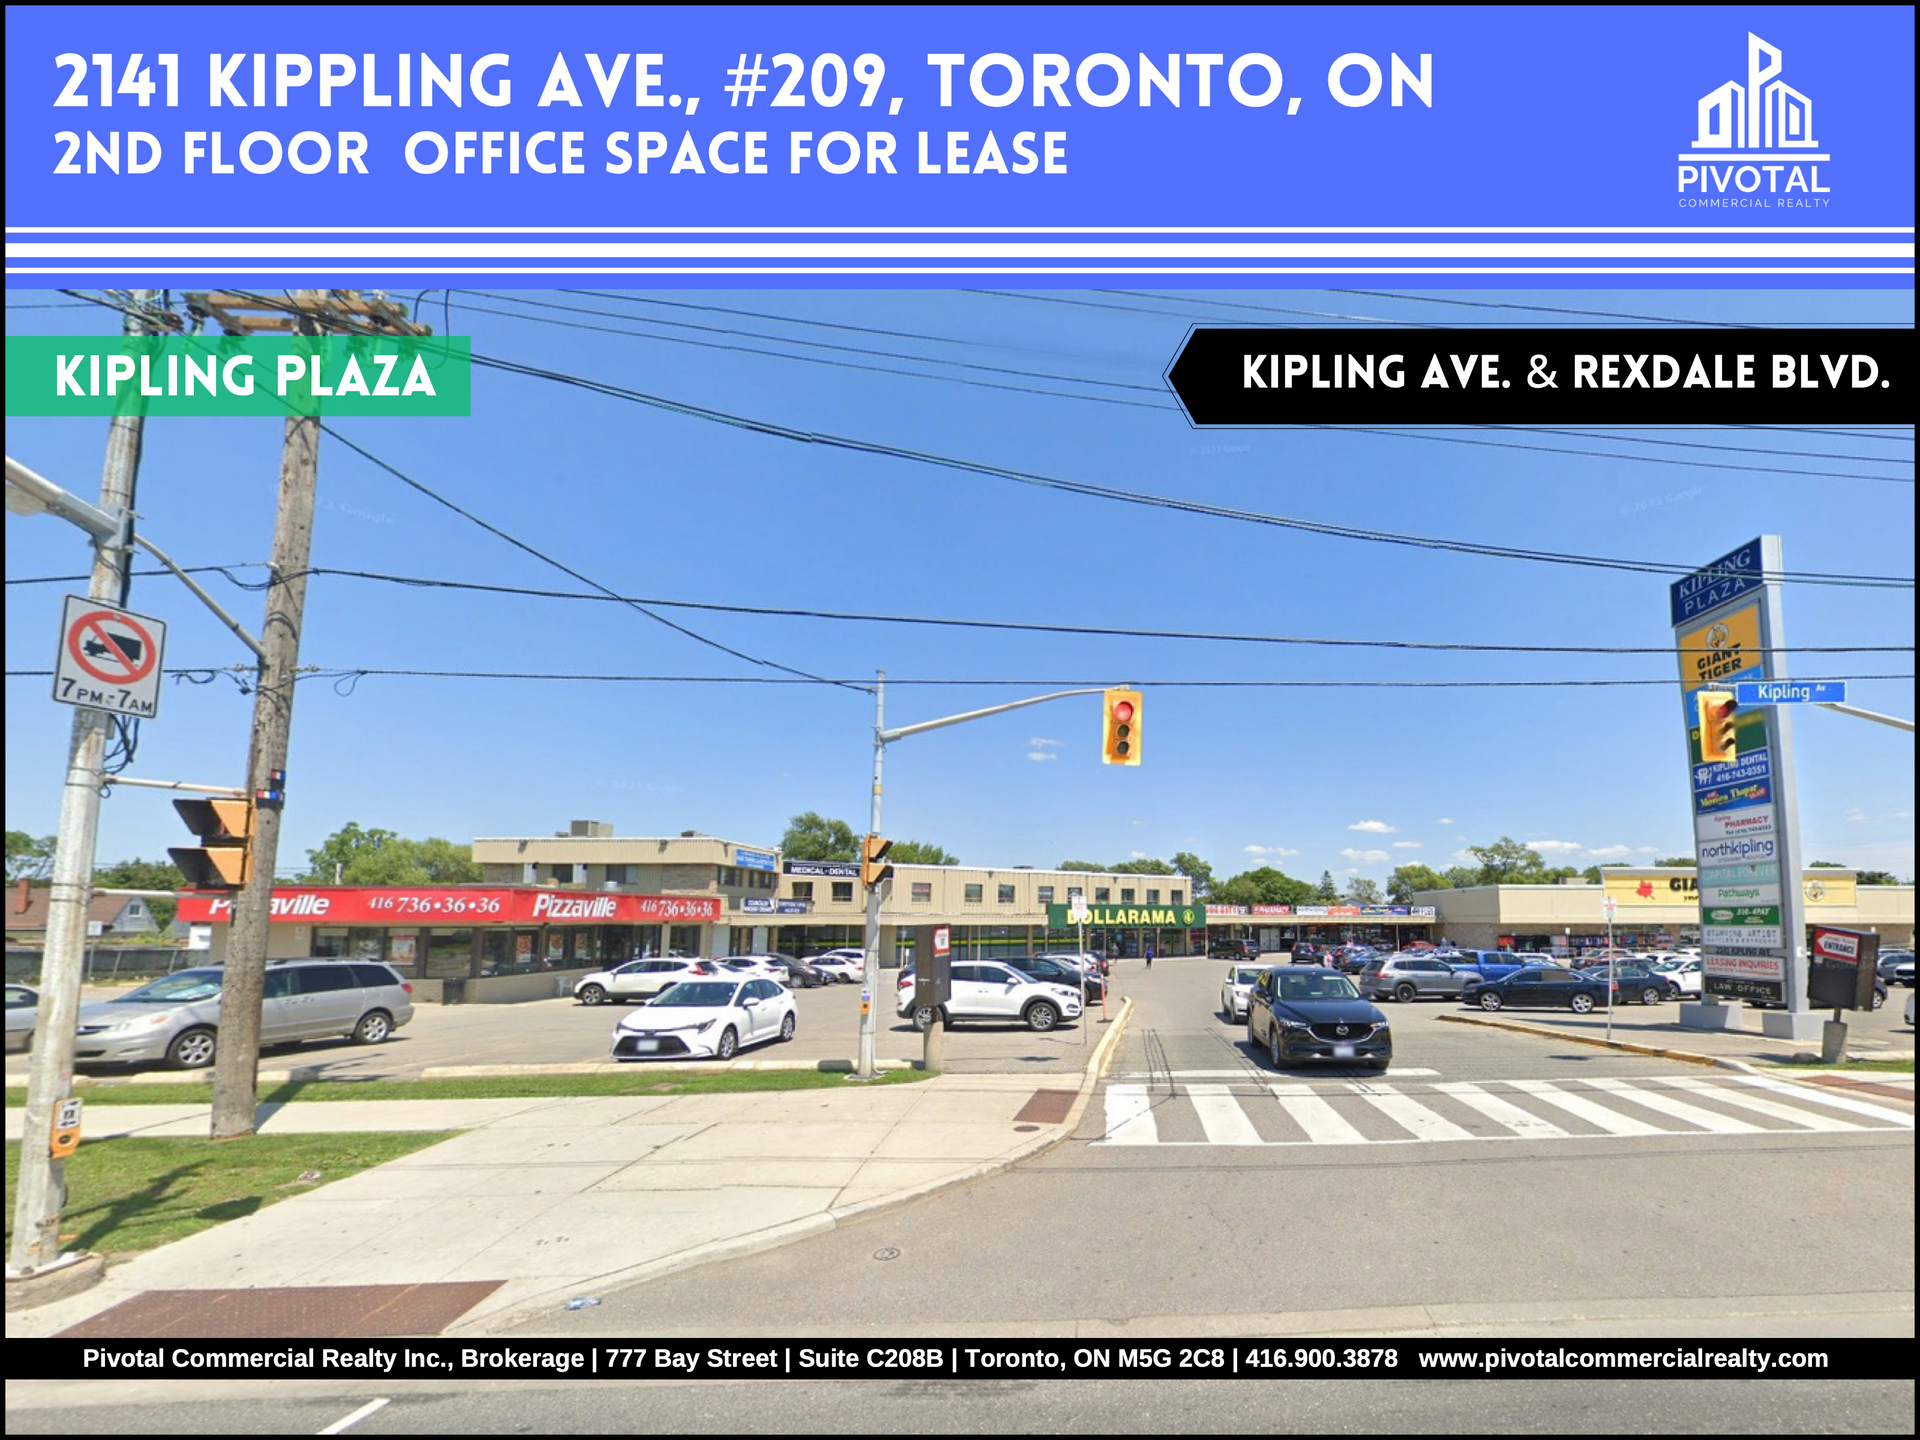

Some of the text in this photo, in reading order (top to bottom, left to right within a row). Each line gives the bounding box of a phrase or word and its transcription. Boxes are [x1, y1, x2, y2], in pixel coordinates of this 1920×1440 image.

[1680, 549, 1751, 599] KIPLING
[1685, 577, 1746, 615] PLAZA
[1697, 644, 1742, 670] GIANT
[1699, 657, 1742, 681] TIGER
[1758, 684, 1811, 702] Kipling
[1741, 752, 1769, 766] DENTAL
[1725, 815, 1769, 829] PHARMACY
[1702, 837, 1774, 858] northkipling
[790, 865, 857, 876] MEDICAL DENTAL
[1718, 888, 1760, 898] Pathways
[368, 897, 393, 909] 416
[532, 894, 617, 918] Pizzaville
[640, 899, 657, 912] 416
[1066, 908, 1176, 925] DOLLARAMA
[1823, 940, 1856, 956] ENTRANCE
[1707, 957, 1737, 967] LEASING
[1738, 959, 1780, 970] INQUIRIES
[1713, 982, 1732, 991] LAW
[1738, 984, 1771, 995] OFFICE
